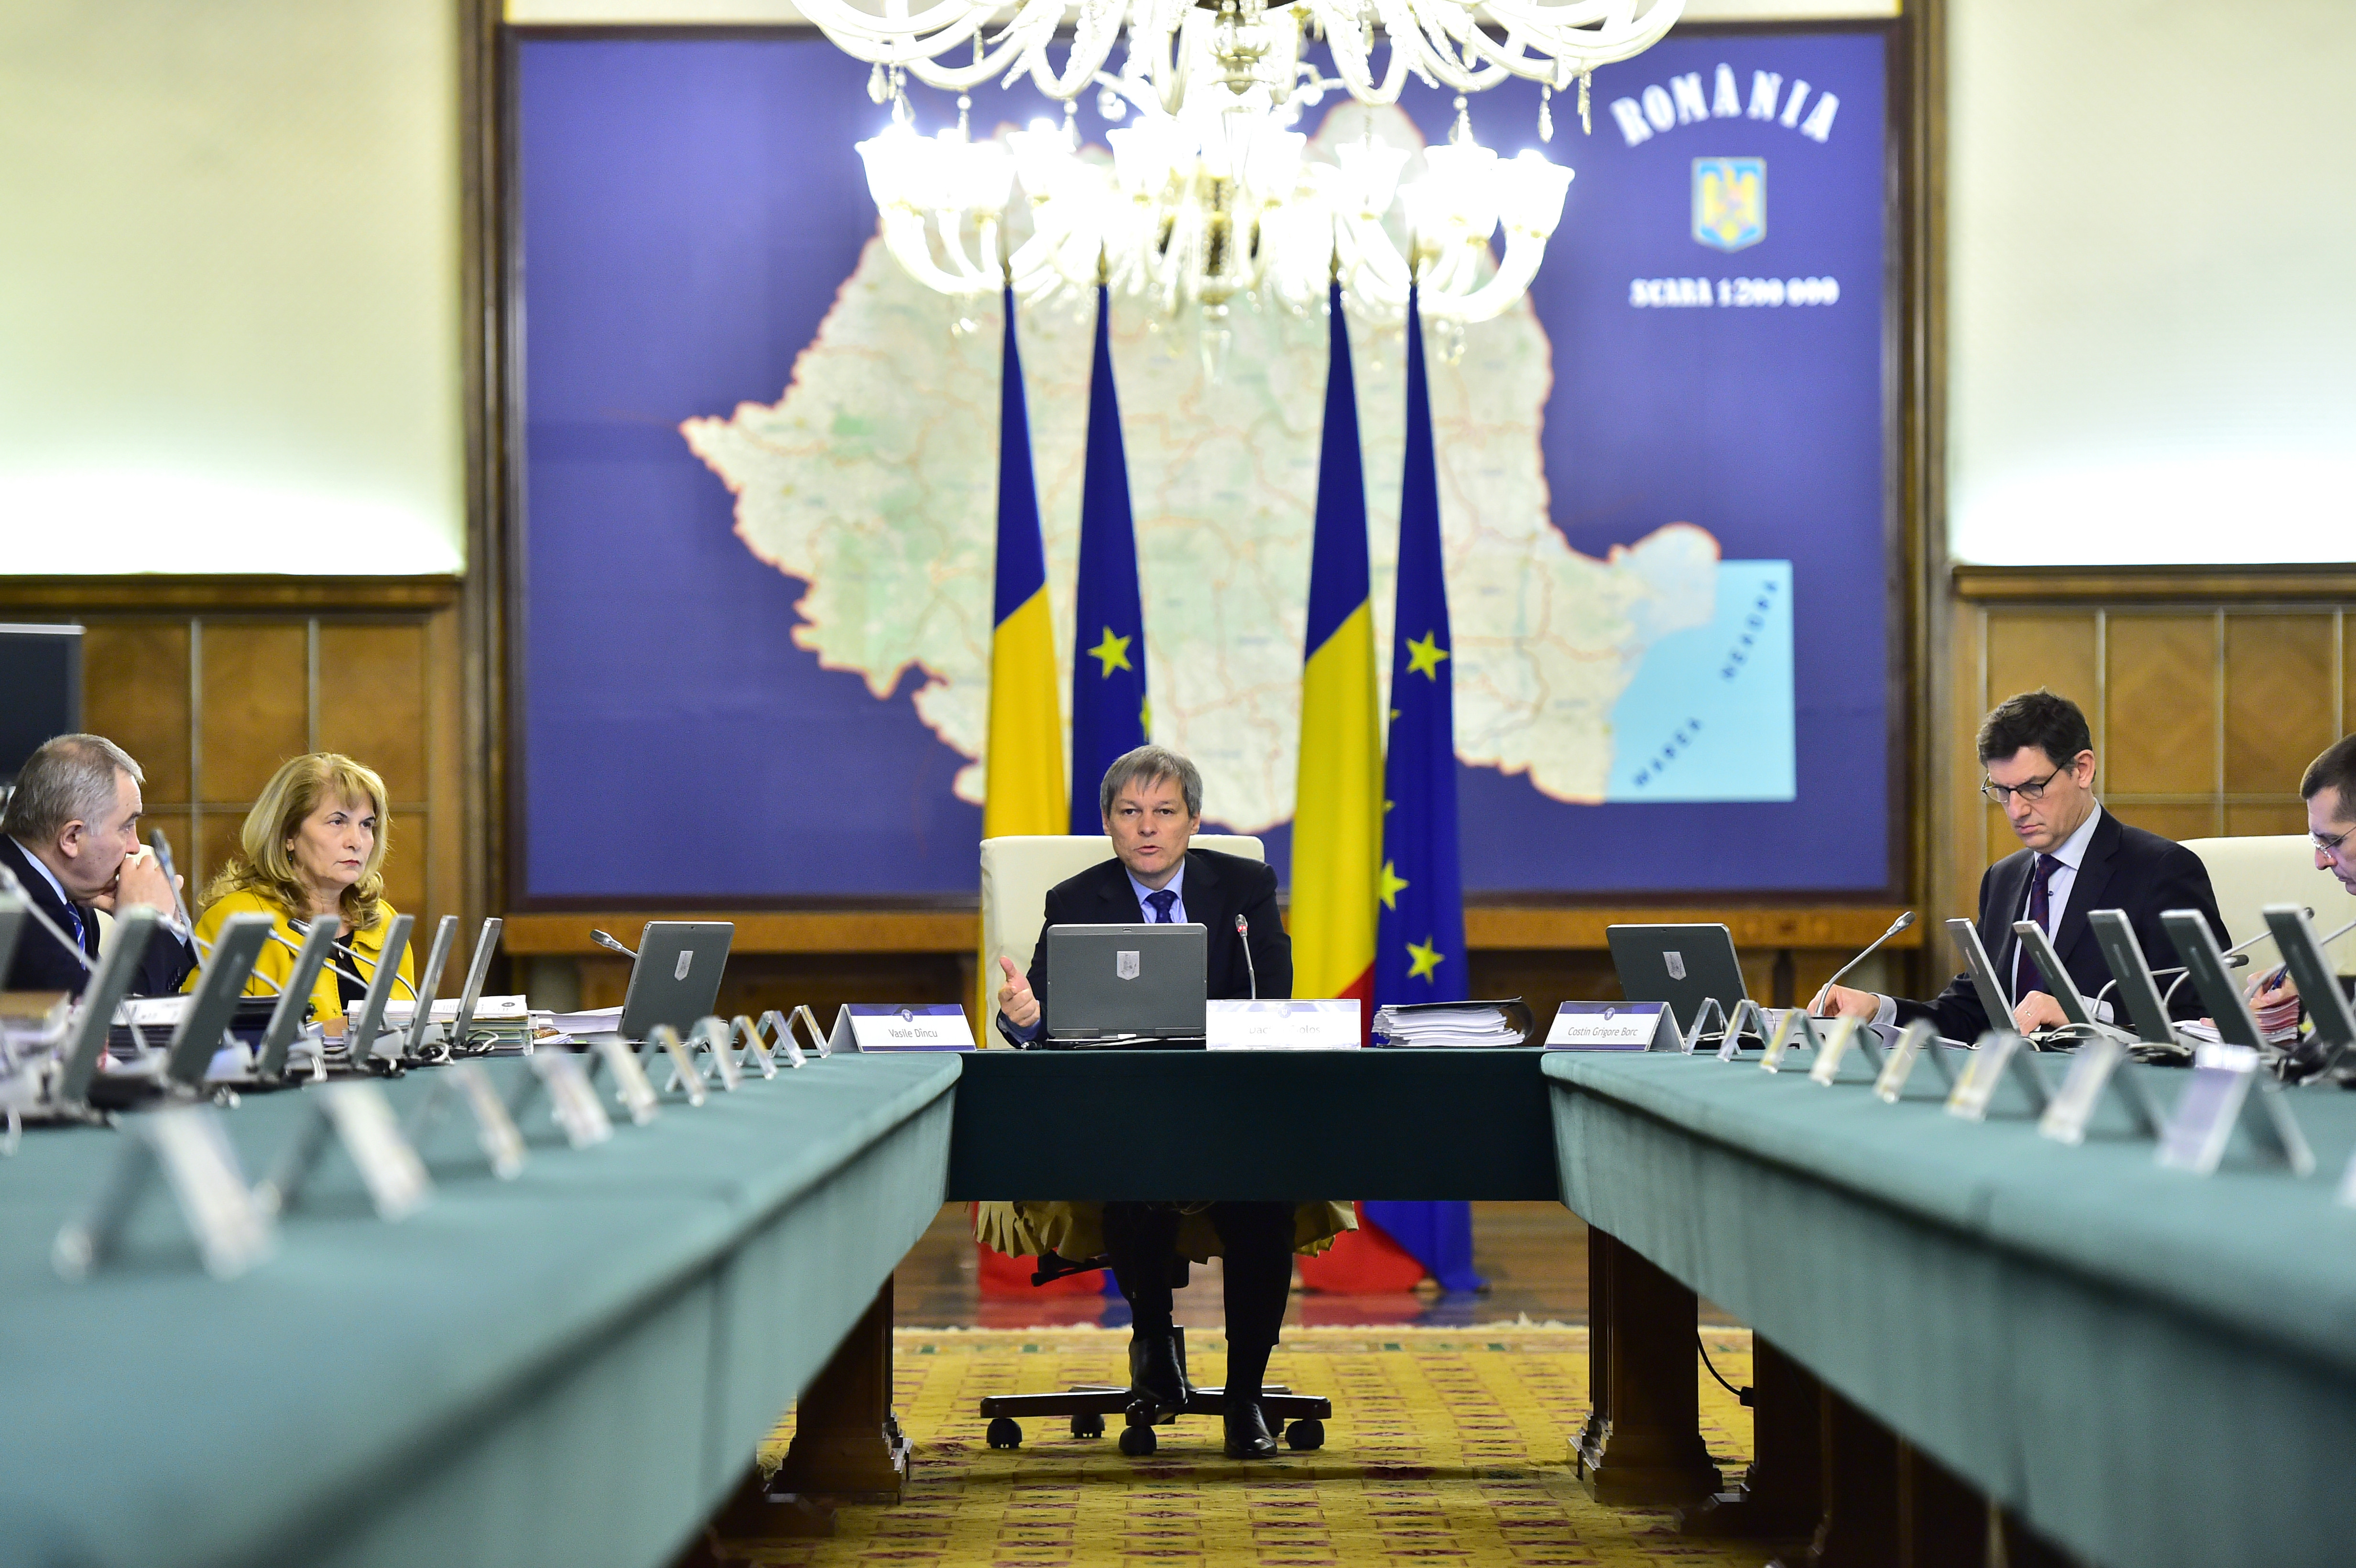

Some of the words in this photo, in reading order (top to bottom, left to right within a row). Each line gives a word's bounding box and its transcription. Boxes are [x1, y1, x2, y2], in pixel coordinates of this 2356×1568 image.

[1629, 278, 1714, 307] SCARA
[888, 1029, 913, 1037] Vasile
[914, 1028, 938, 1037] Dîncu
[1568, 1027, 1591, 1035] Costin
[1592, 1027, 1620, 1038] Grigore
[1621, 1027, 1638, 1035] Borc
